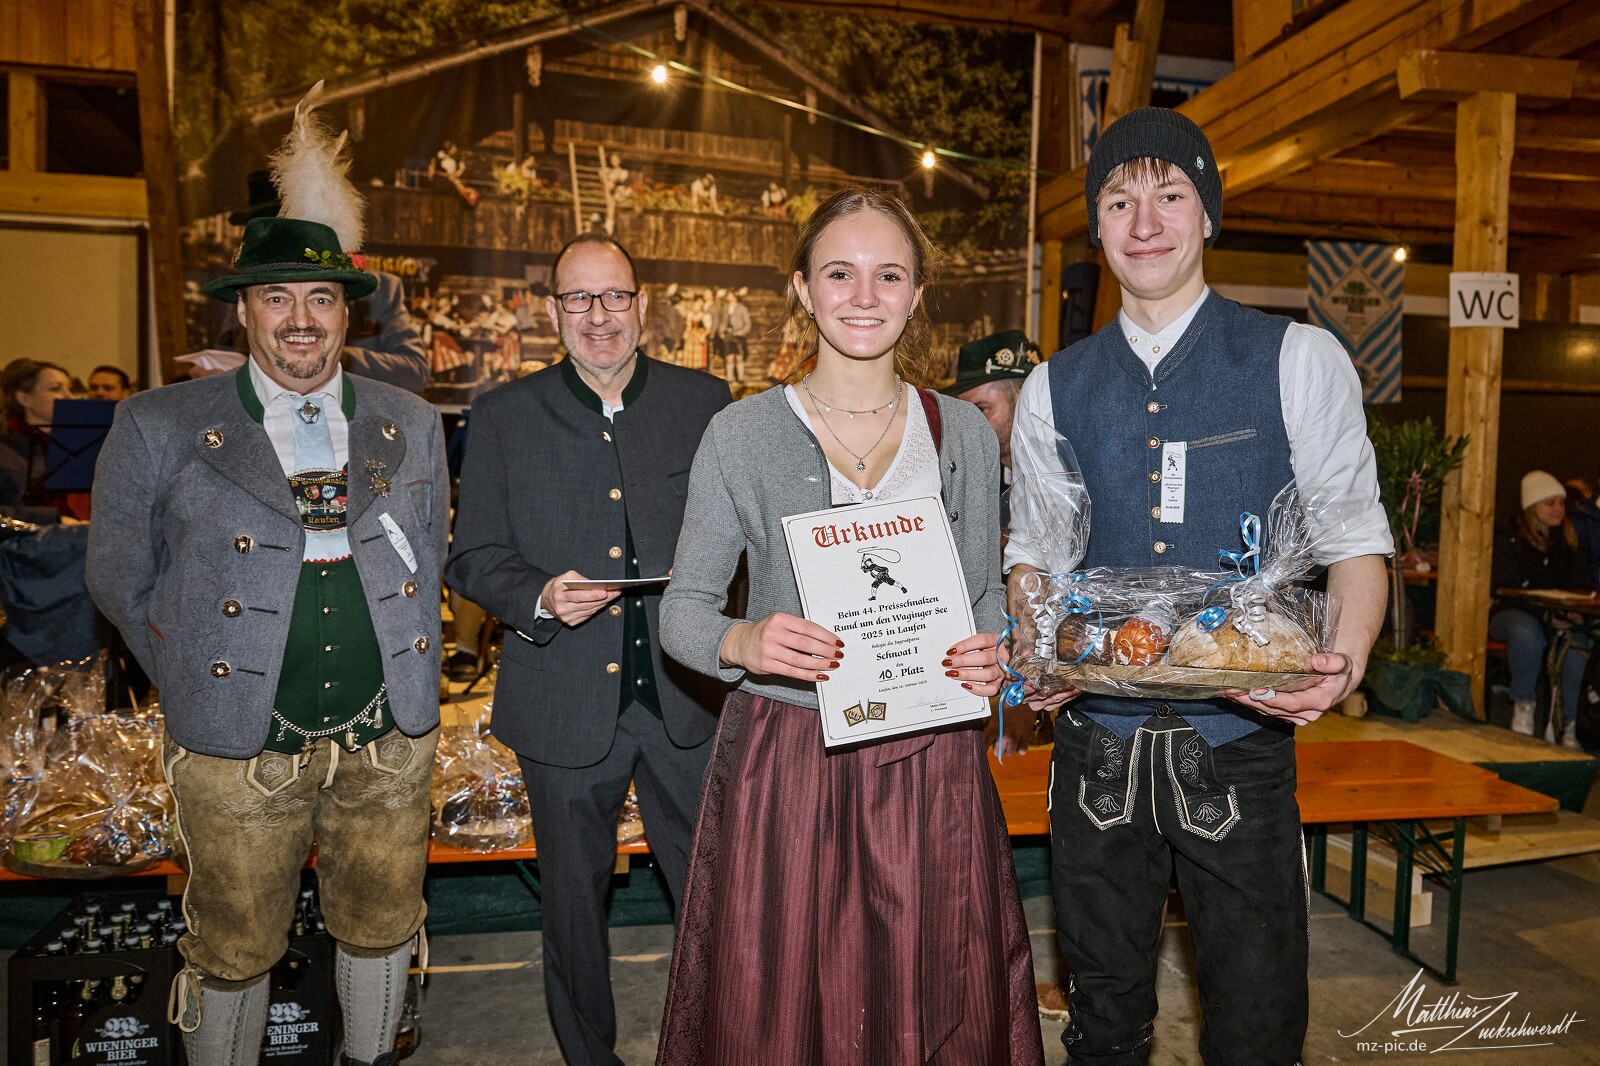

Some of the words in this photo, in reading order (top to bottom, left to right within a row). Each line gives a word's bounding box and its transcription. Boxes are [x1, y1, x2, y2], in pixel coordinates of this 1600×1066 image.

[1458, 289, 1514, 321] WC
[811, 514, 925, 548] Urkunde
[837, 610, 860, 619] Beim
[879, 595, 939, 612] Preisschnalzen
[834, 621, 858, 632] Rund
[860, 620, 874, 628] um
[876, 616, 891, 625] den
[891, 610, 933, 623] Waginger
[934, 606, 948, 615] See
[861, 629, 883, 640] 2025
[886, 628, 895, 636] in
[897, 622, 927, 635] Laufen
[876, 648, 912, 661] Schnoat
[901, 666, 925, 677] Platz
[267, 1022, 320, 1035] ENINGER
[85, 1037, 159, 1053] WIENINGER
[270, 1033, 299, 1045] BIER
[107, 1049, 138, 1061] BIER
